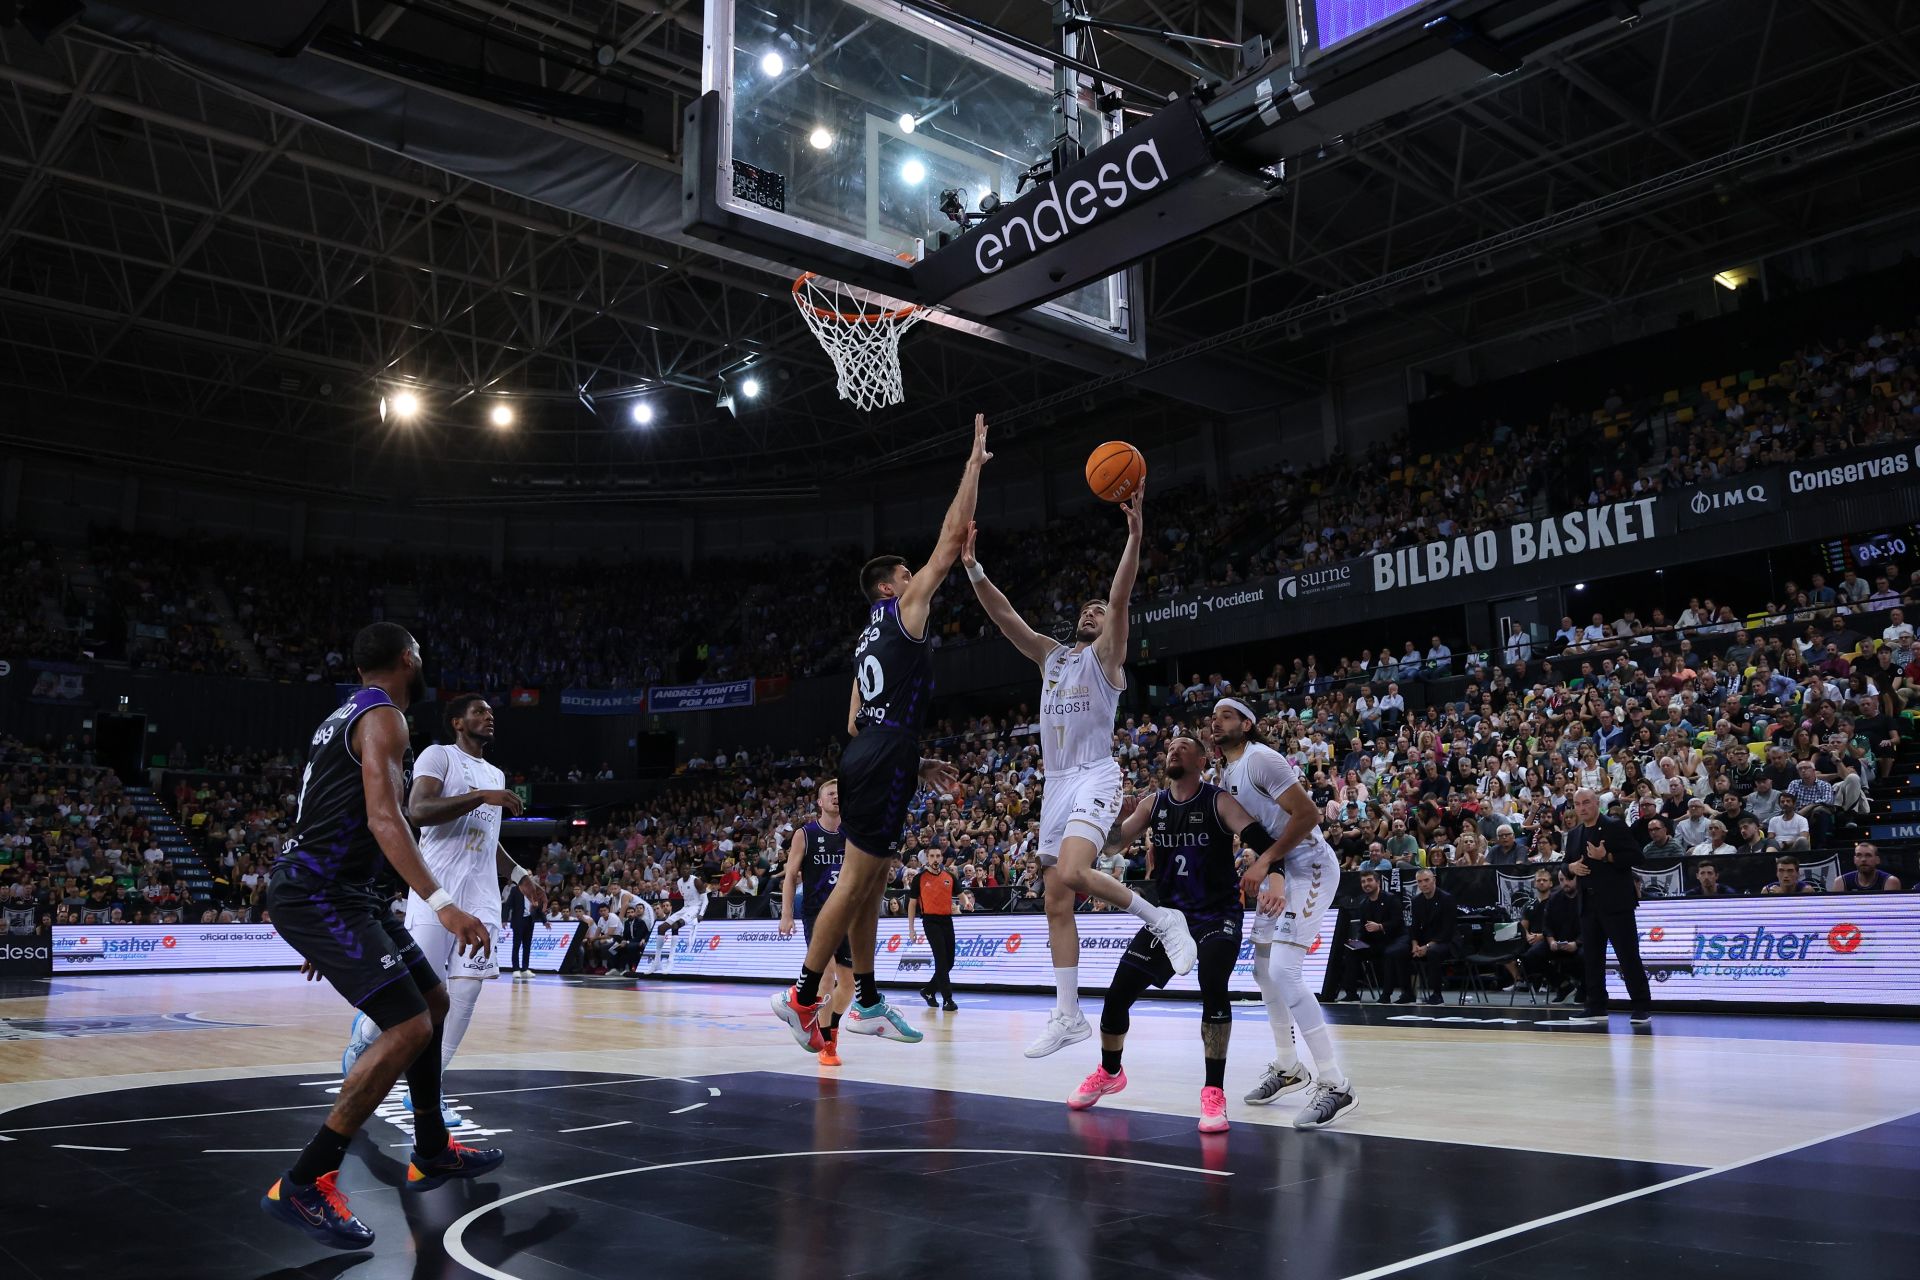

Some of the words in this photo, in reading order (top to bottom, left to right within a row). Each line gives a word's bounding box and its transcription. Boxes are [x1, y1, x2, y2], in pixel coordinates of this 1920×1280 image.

[976, 138, 1169, 275] endesa
[1789, 453, 1909, 494] Conservas
[1713, 485, 1768, 509] IMQ
[1374, 529, 1499, 592] BILBAO
[1511, 497, 1657, 565] BASKET
[1301, 565, 1350, 588] surne
[1215, 588, 1264, 609] Occident
[1145, 598, 1199, 623] vueling
[703, 683, 749, 695] MONTES
[1155, 831, 1210, 848] surne
[1175, 855, 1189, 876] 2
[245, 932, 253, 940] la
[255, 932, 273, 940] acb
[1081, 937, 1097, 949] de
[1098, 937, 1110, 949] la
